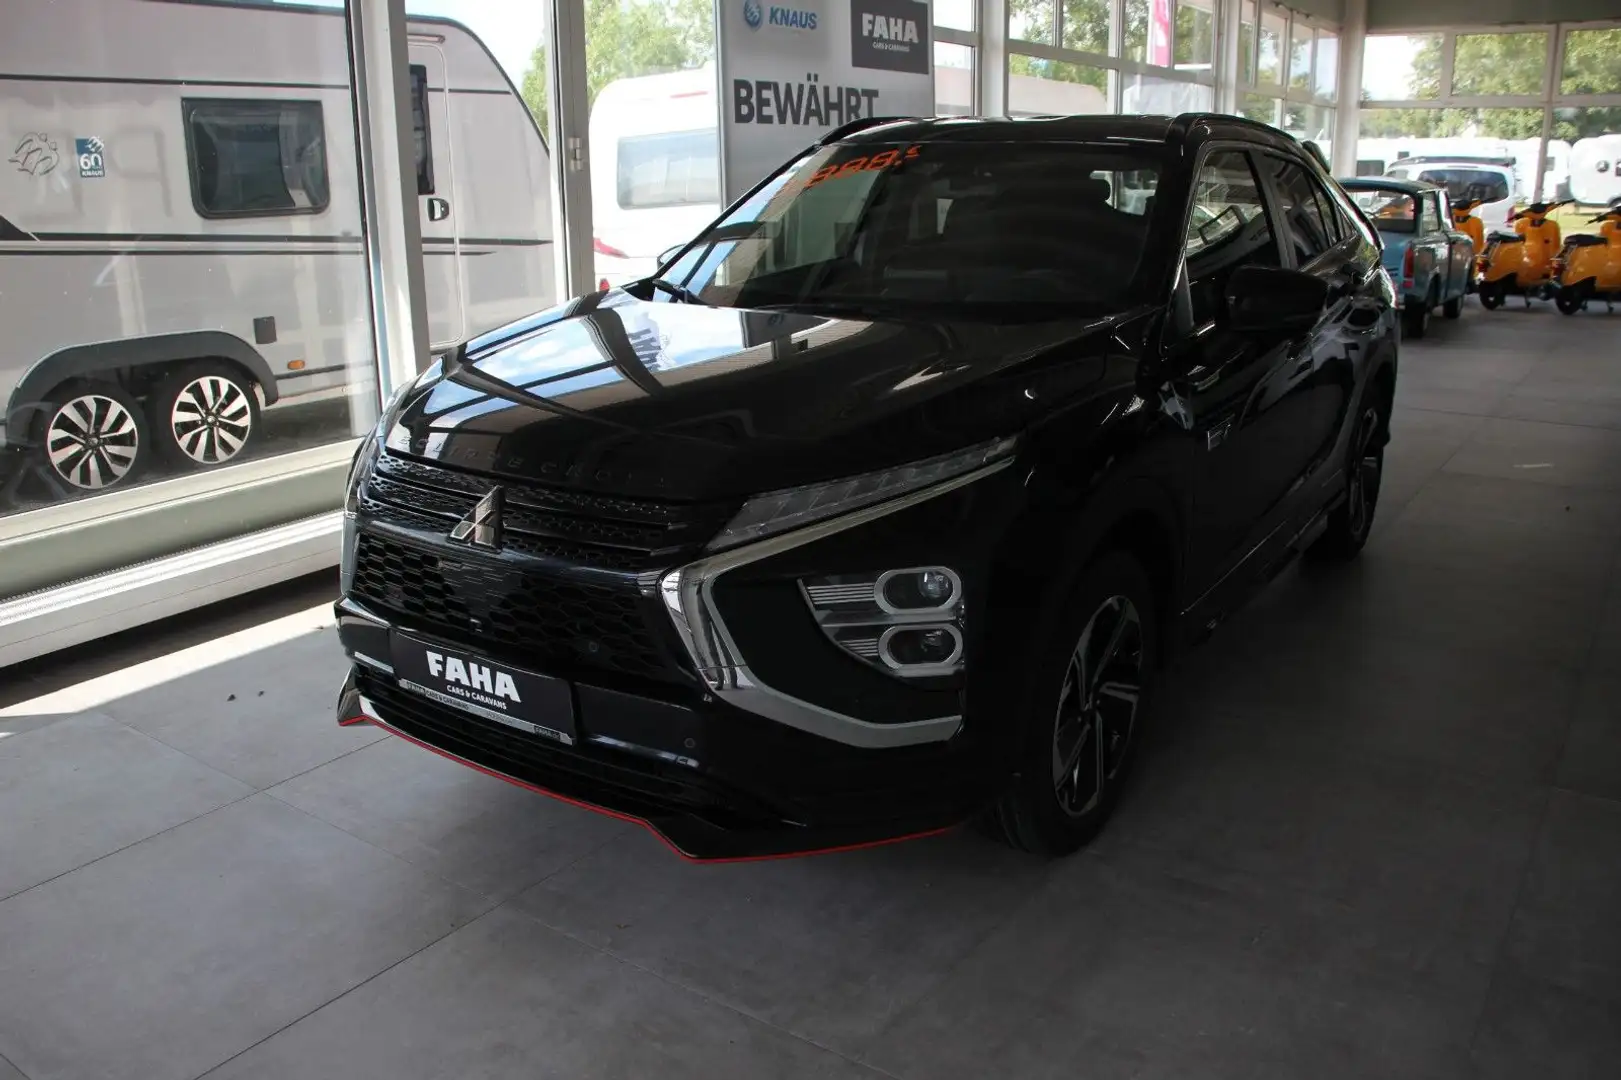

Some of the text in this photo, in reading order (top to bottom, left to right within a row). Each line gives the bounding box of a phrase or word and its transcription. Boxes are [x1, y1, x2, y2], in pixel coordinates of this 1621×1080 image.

[769, 6, 818, 30] KNAUS
[862, 12, 919, 44] FAHA
[733, 73, 879, 126] BEWÄHRT
[80, 153, 102, 170] 60
[425, 650, 522, 703] FAHA
[446, 684, 465, 697] CARS
[471, 692, 507, 710] CARAVANS
